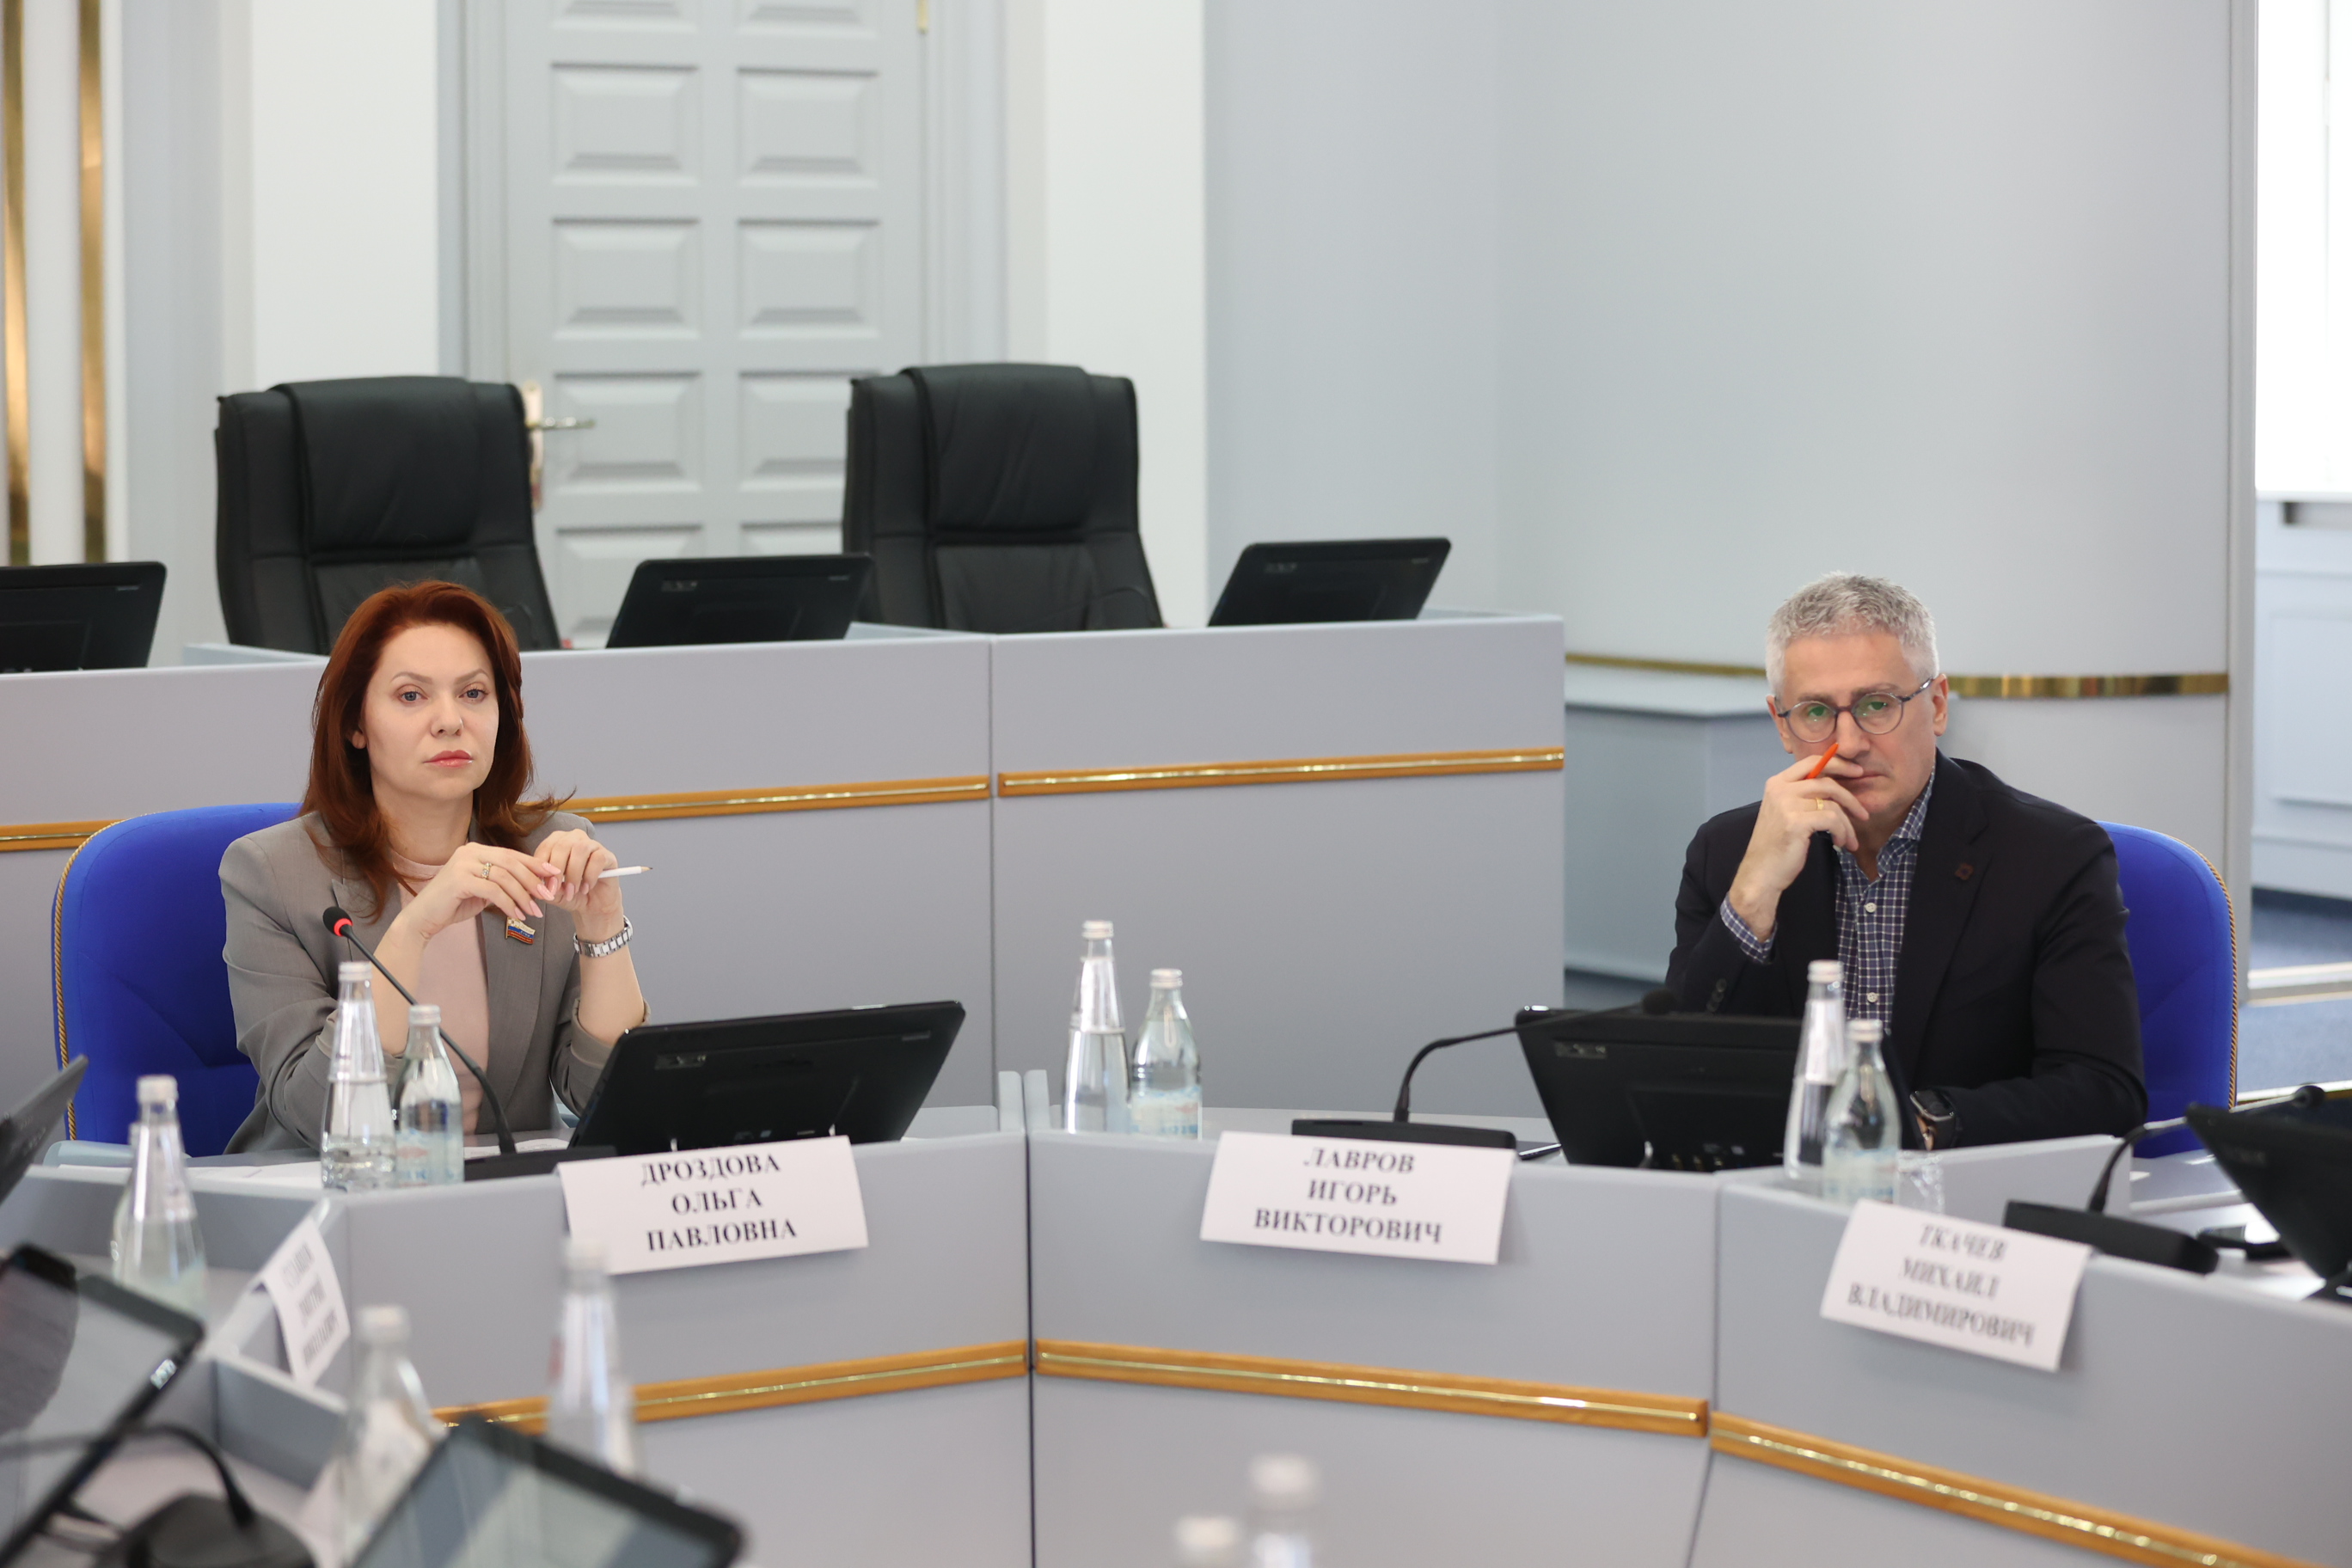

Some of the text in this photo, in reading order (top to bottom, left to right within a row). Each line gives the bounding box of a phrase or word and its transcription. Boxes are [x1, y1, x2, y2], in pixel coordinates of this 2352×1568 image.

[640, 1153, 781, 1187] ДРОЗДОВА
[1303, 1148, 1416, 1174] ЛАВРОВ
[671, 1188, 763, 1216] ОЛЬГА
[1307, 1179, 1398, 1205] ИГОРЬ
[646, 1218, 798, 1253] ПАВЛОВНА
[1253, 1208, 1443, 1245] ВИКТОРОВИЧ
[1918, 1222, 2008, 1262] ТКАЧЕВ
[1898, 1256, 2001, 1300] МИХАИЛ
[1847, 1281, 2037, 1348] ВЛАДИМИРОВИЧ
